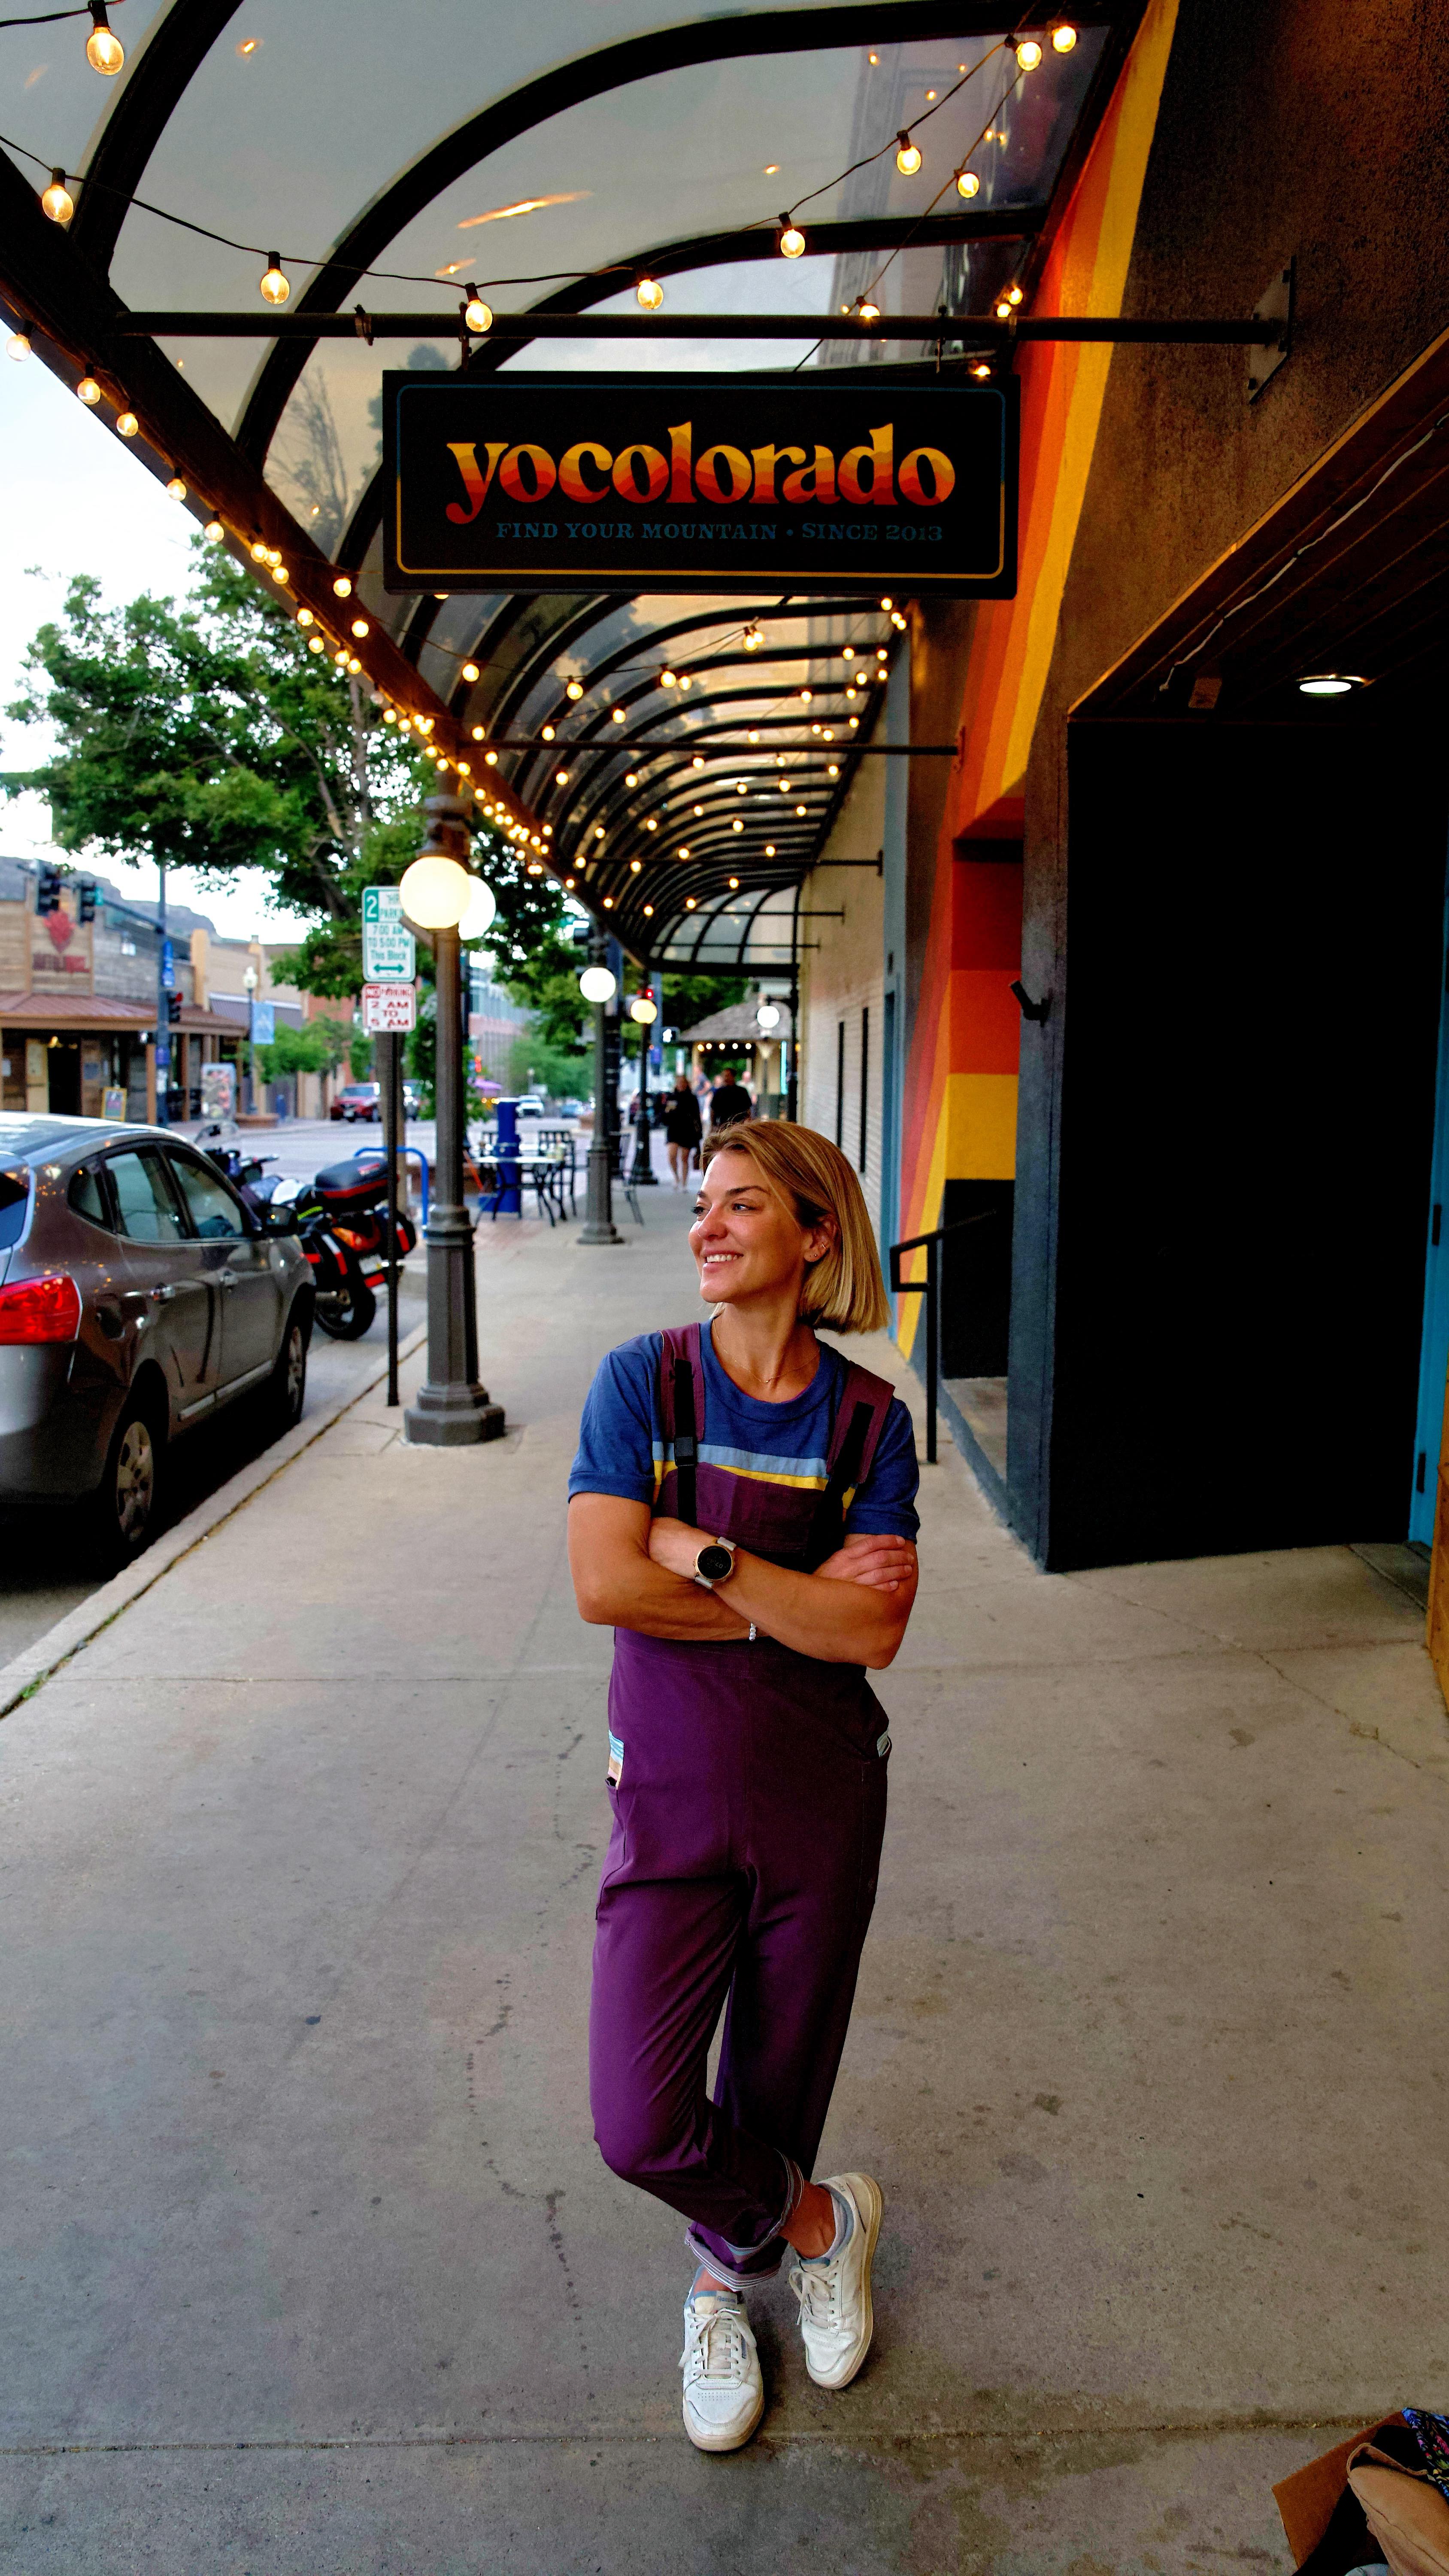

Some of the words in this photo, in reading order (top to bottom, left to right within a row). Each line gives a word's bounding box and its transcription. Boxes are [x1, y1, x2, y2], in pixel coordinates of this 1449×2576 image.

[446, 421, 955, 524] yocolorado
[497, 522, 558, 538] FIND
[564, 523, 634, 538] YOUR
[643, 523, 776, 540] MOUNTAIN
[802, 522, 878, 540] SINCE
[886, 525, 943, 541] 2013
[367, 895, 377, 917] 2
[388, 1001, 409, 1009] AM
[388, 1018, 409, 1027] AM
